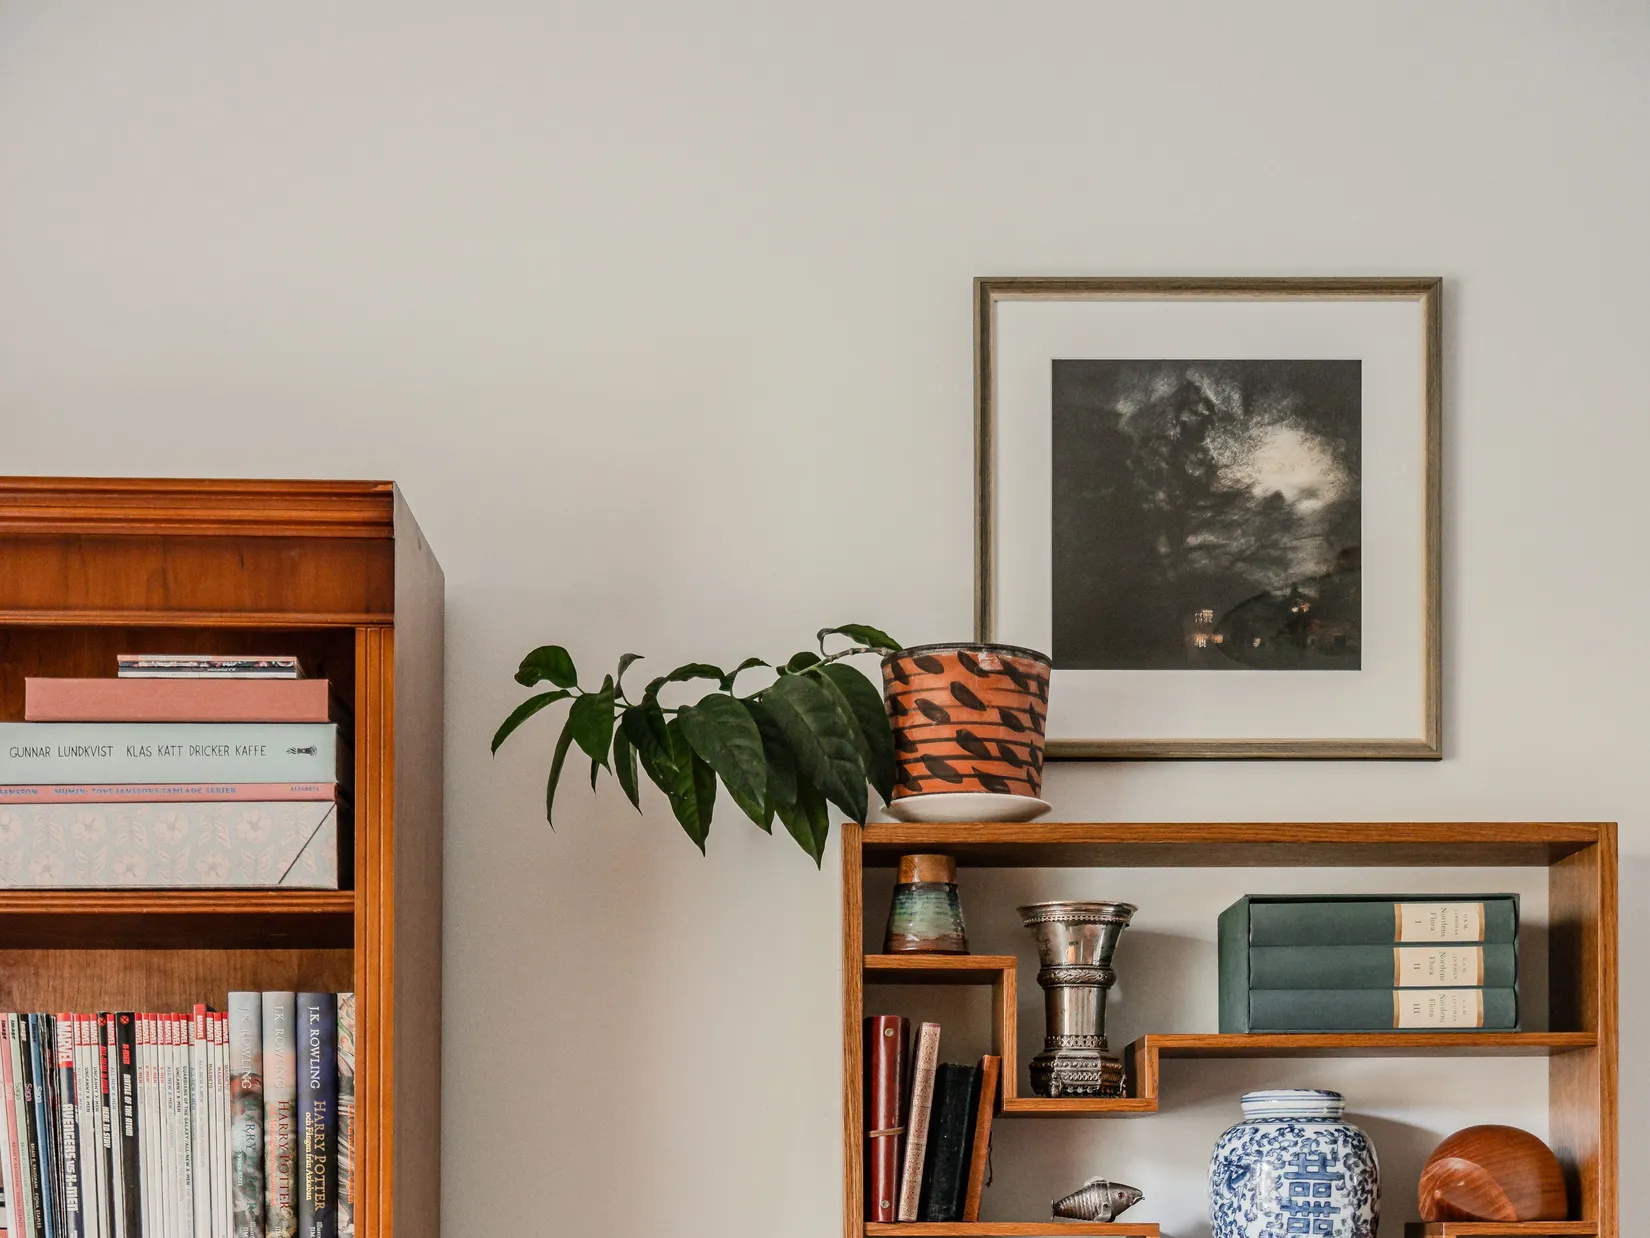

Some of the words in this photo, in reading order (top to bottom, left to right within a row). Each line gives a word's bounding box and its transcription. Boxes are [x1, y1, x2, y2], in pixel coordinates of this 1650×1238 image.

[10, 746, 50, 758] GUNNAR
[58, 746, 114, 757] LUNDKVIST
[127, 746, 152, 757] KLAS
[158, 745, 183, 757] KATT
[189, 745, 229, 756] DRICKER
[235, 745, 266, 756] KAFFE
[308, 1006, 319, 1024] J.K.
[57, 1021, 72, 1064] MARVEL
[82, 1021, 90, 1044] MARVEL
[90, 1022, 98, 1044] MARVEL
[122, 1044, 130, 1064] X-MEN
[275, 1028, 284, 1088] ROWLING
[310, 1029, 320, 1089] ROWLING
[102, 1106, 110, 1122] HERE
[62, 1104, 75, 1159] AVENGERS
[103, 1123, 110, 1131] TO
[125, 1118, 133, 1136] ATOM
[278, 1101, 289, 1151] HARRY
[314, 1101, 326, 1151] HARRY
[103, 1133, 111, 1148] STAY
[304, 1127, 313, 1152] Fången
[306, 1154, 314, 1168] från
[66, 1175, 79, 1212] X-MEN
[279, 1155, 290, 1209] POTTER
[315, 1155, 326, 1211] POTTER
